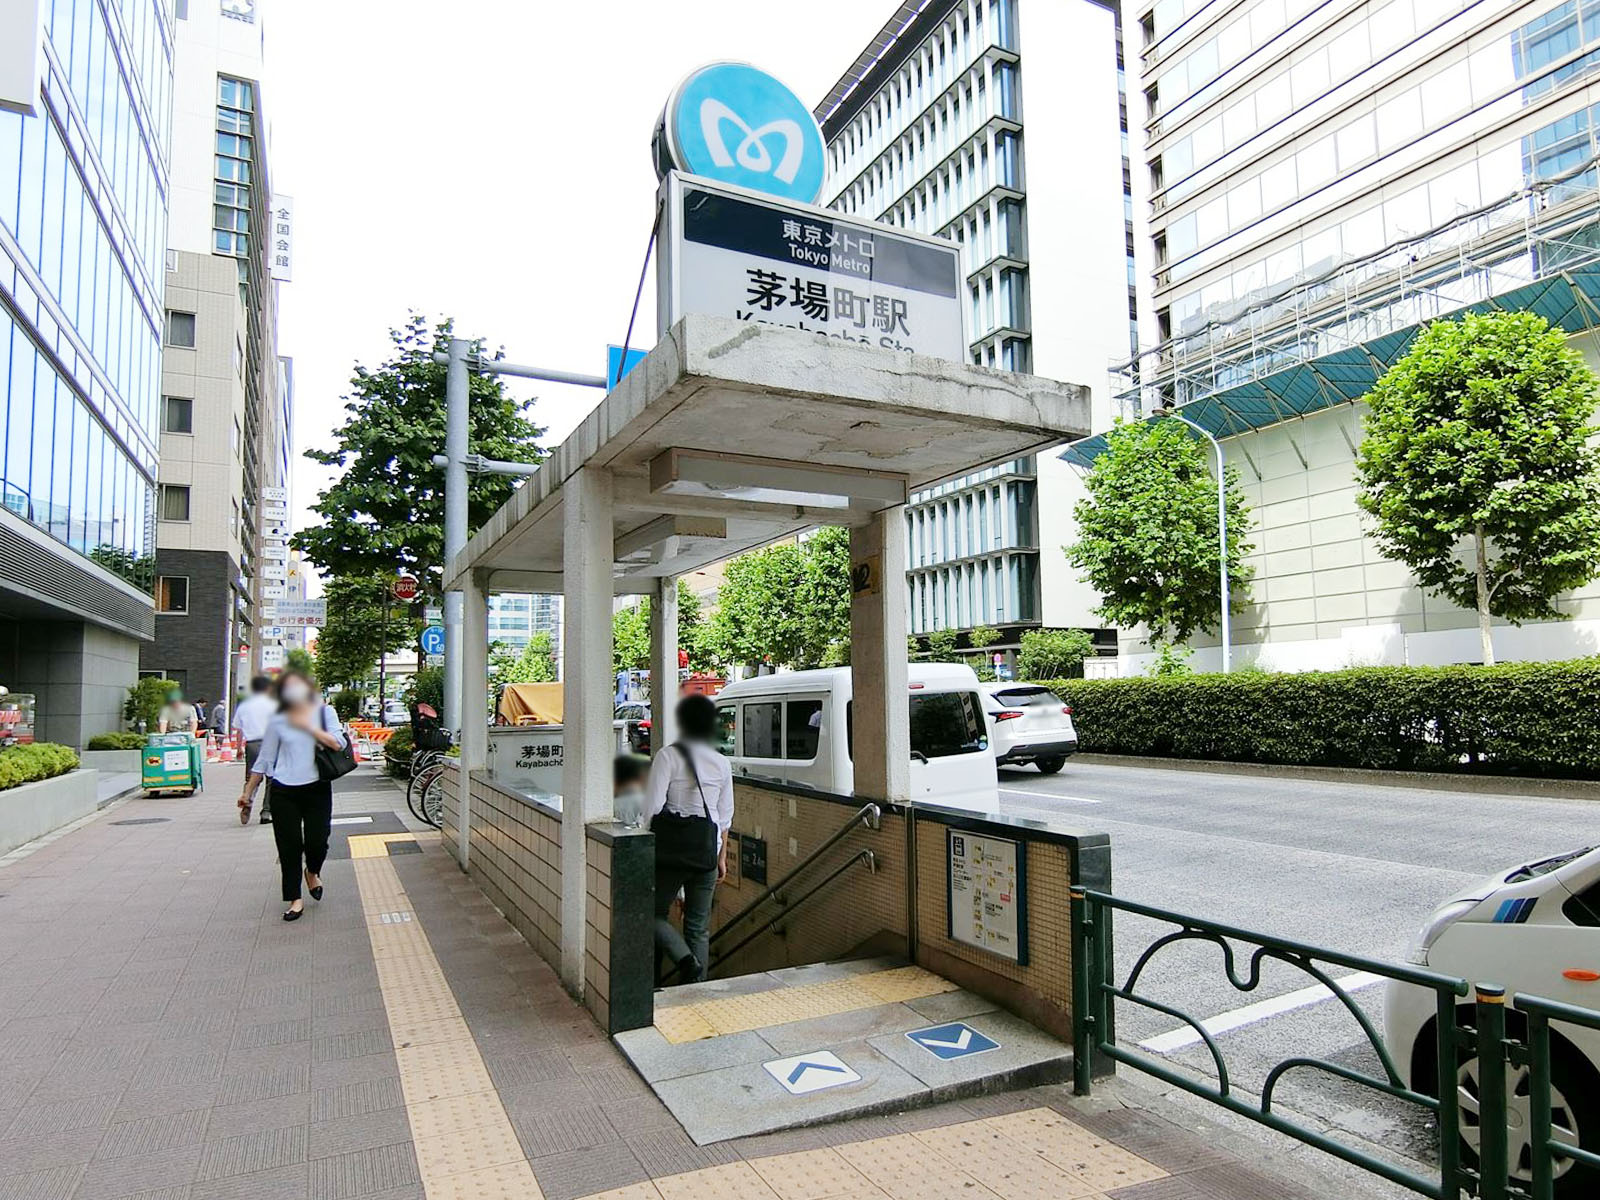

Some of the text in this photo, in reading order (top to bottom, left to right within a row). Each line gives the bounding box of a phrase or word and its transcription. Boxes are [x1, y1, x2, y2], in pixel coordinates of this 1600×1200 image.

[276, 208, 290, 267] 全国会館
[782, 219, 875, 259] 東京メトロ
[788, 244, 871, 274] Tokyo Metro
[746, 268, 911, 337] 茅場町駅
[272, 627, 281, 637] P
[279, 616, 323, 626] 歩行者優先
[428, 634, 440, 652] P
[521, 744, 563, 759] 茅場町
